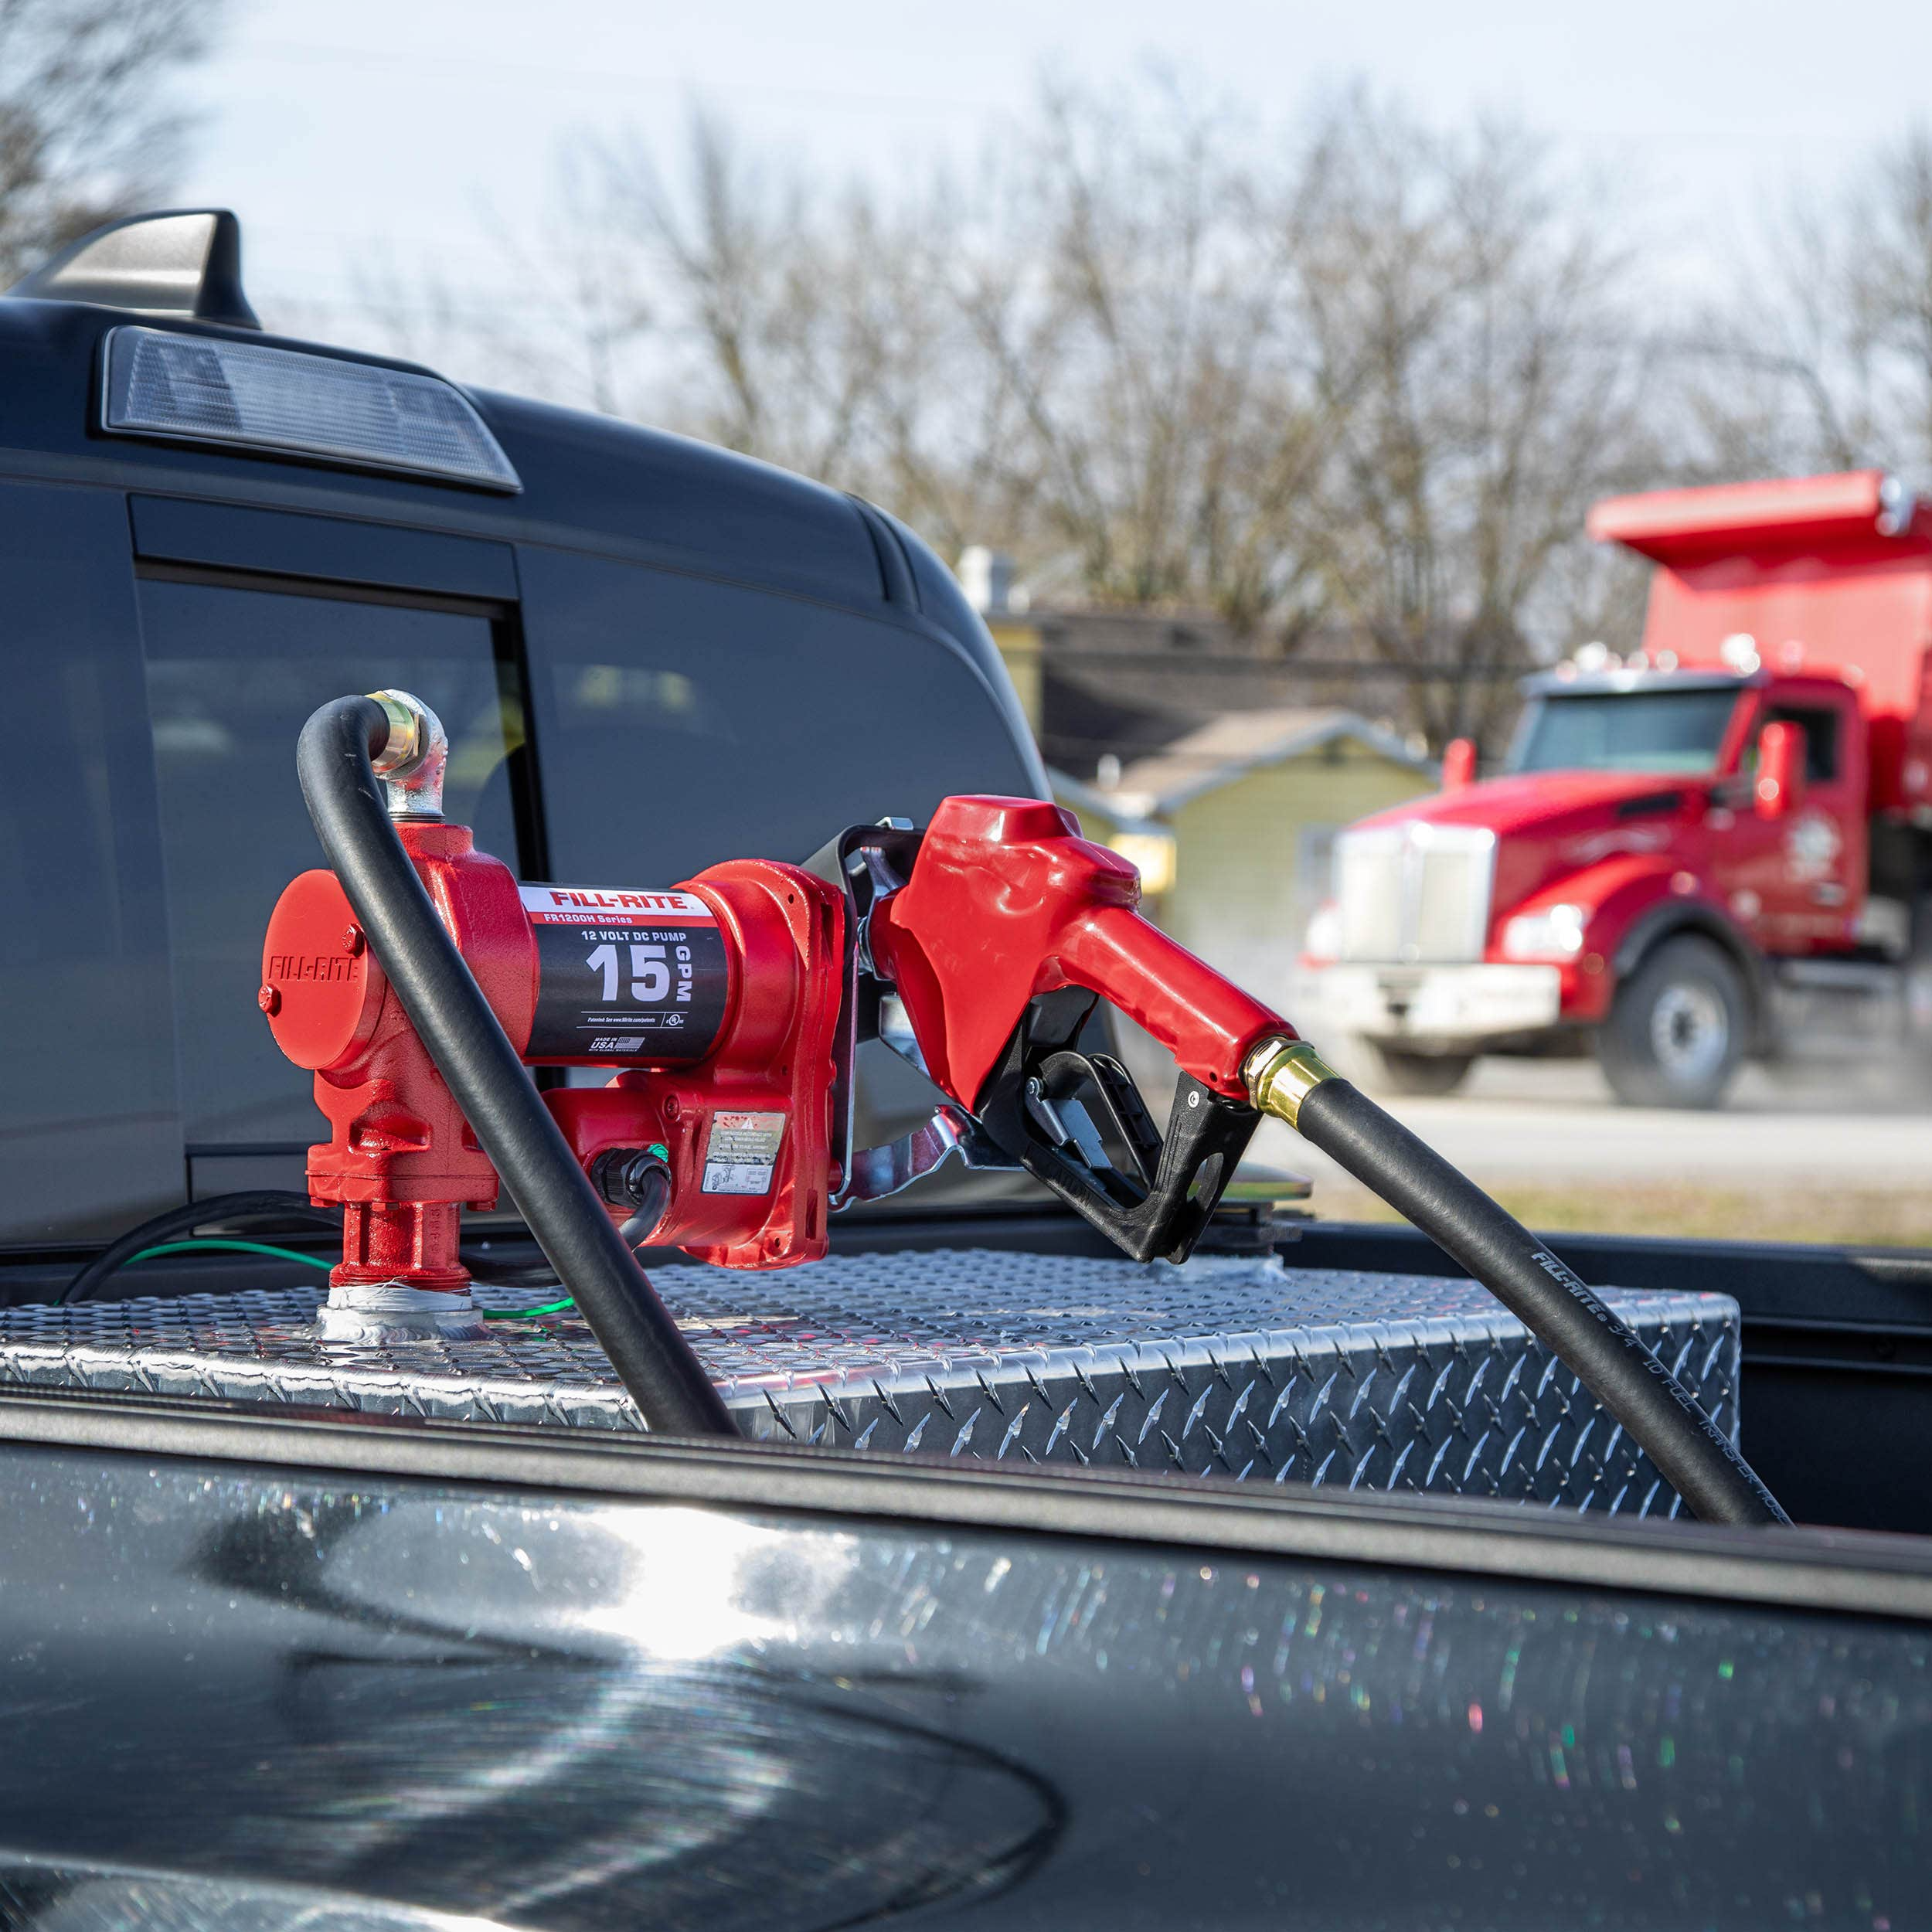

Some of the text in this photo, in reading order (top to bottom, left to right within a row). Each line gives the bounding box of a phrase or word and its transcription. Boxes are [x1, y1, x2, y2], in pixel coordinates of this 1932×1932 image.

[549, 891, 688, 910] FILL-RITE
[543, 913, 633, 924] FR1200H Series
[581, 930, 687, 942] 12 VOLT DC PUMP
[268, 955, 361, 983] FILL-RITE
[586, 944, 671, 1002] 15
[675, 945, 692, 1002] GPM
[1662, 1379, 1694, 1413] FUEL
[1698, 1420, 1759, 1485] TRANSFER
